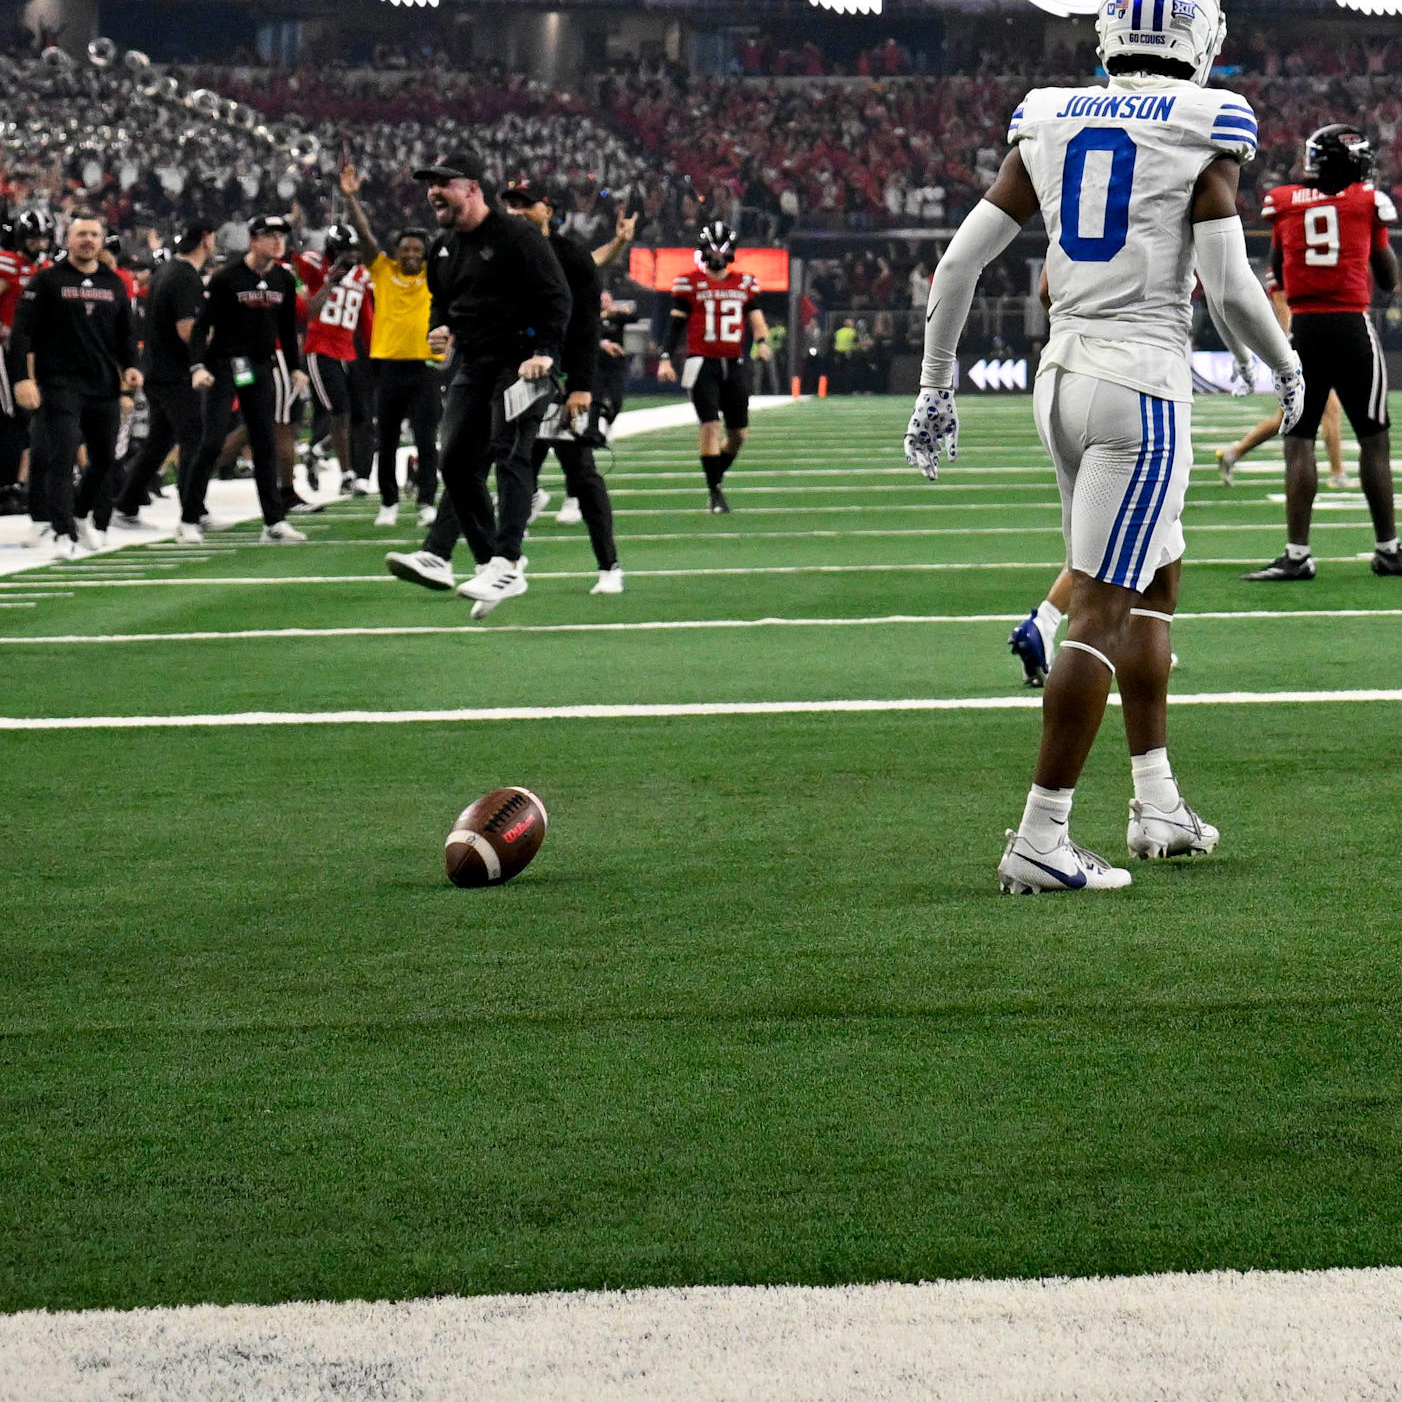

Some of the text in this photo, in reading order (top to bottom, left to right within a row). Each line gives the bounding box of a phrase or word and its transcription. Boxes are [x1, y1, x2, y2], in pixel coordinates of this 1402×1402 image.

[1129, 33, 1166, 45] GO COUGS
[1057, 96, 1177, 122] JOHNSON
[1058, 127, 1137, 262] 0
[1304, 205, 1341, 267] 9
[320, 286, 364, 330] 88
[703, 299, 744, 343] 12
